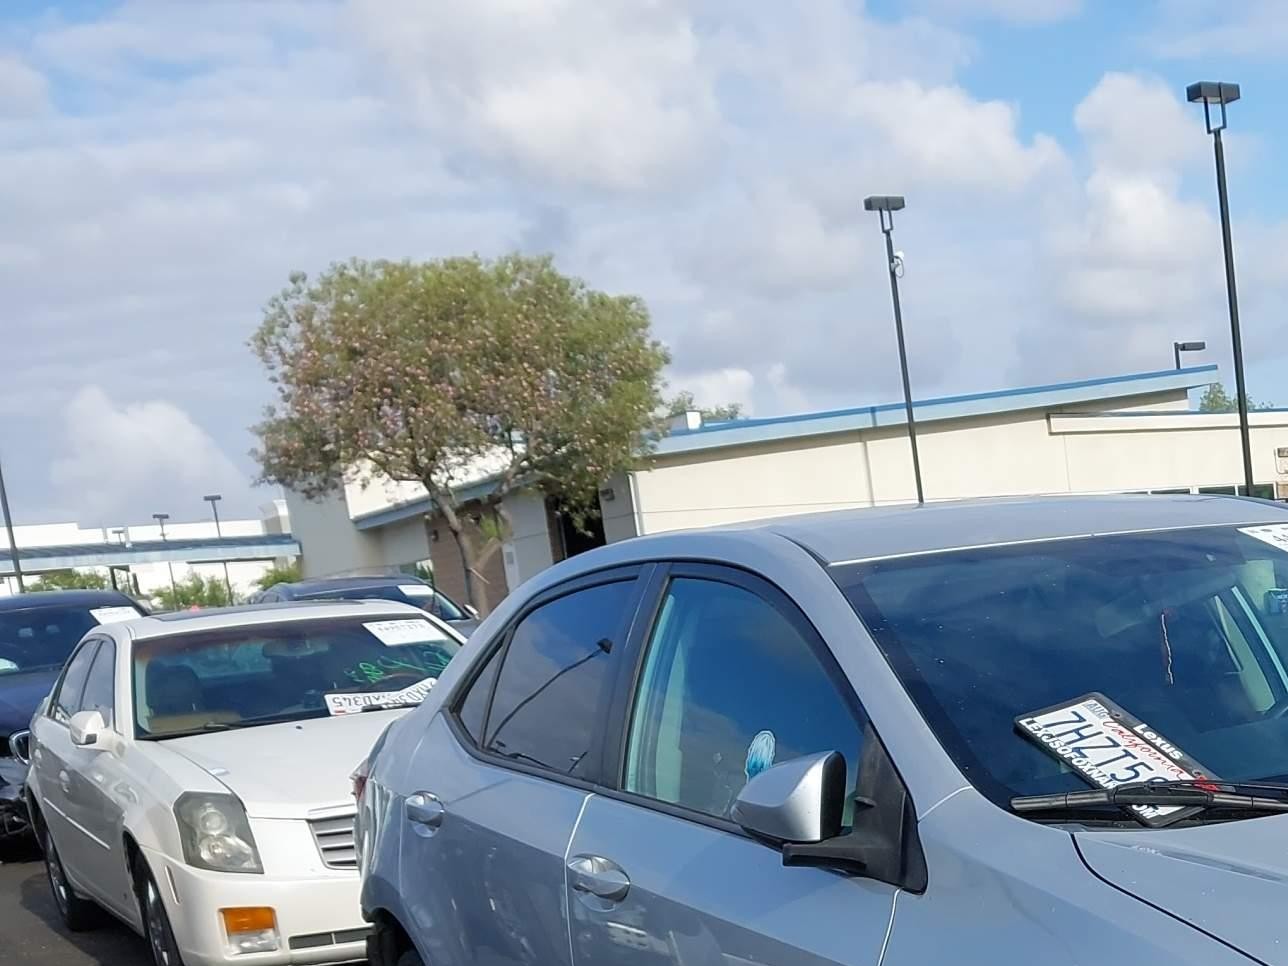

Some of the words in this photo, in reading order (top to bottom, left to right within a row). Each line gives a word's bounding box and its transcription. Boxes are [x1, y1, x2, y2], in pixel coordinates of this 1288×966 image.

[1043, 711, 1169, 809] 7HZT5
[1103, 720, 1188, 779] California
[1134, 723, 1185, 760] Lexus
